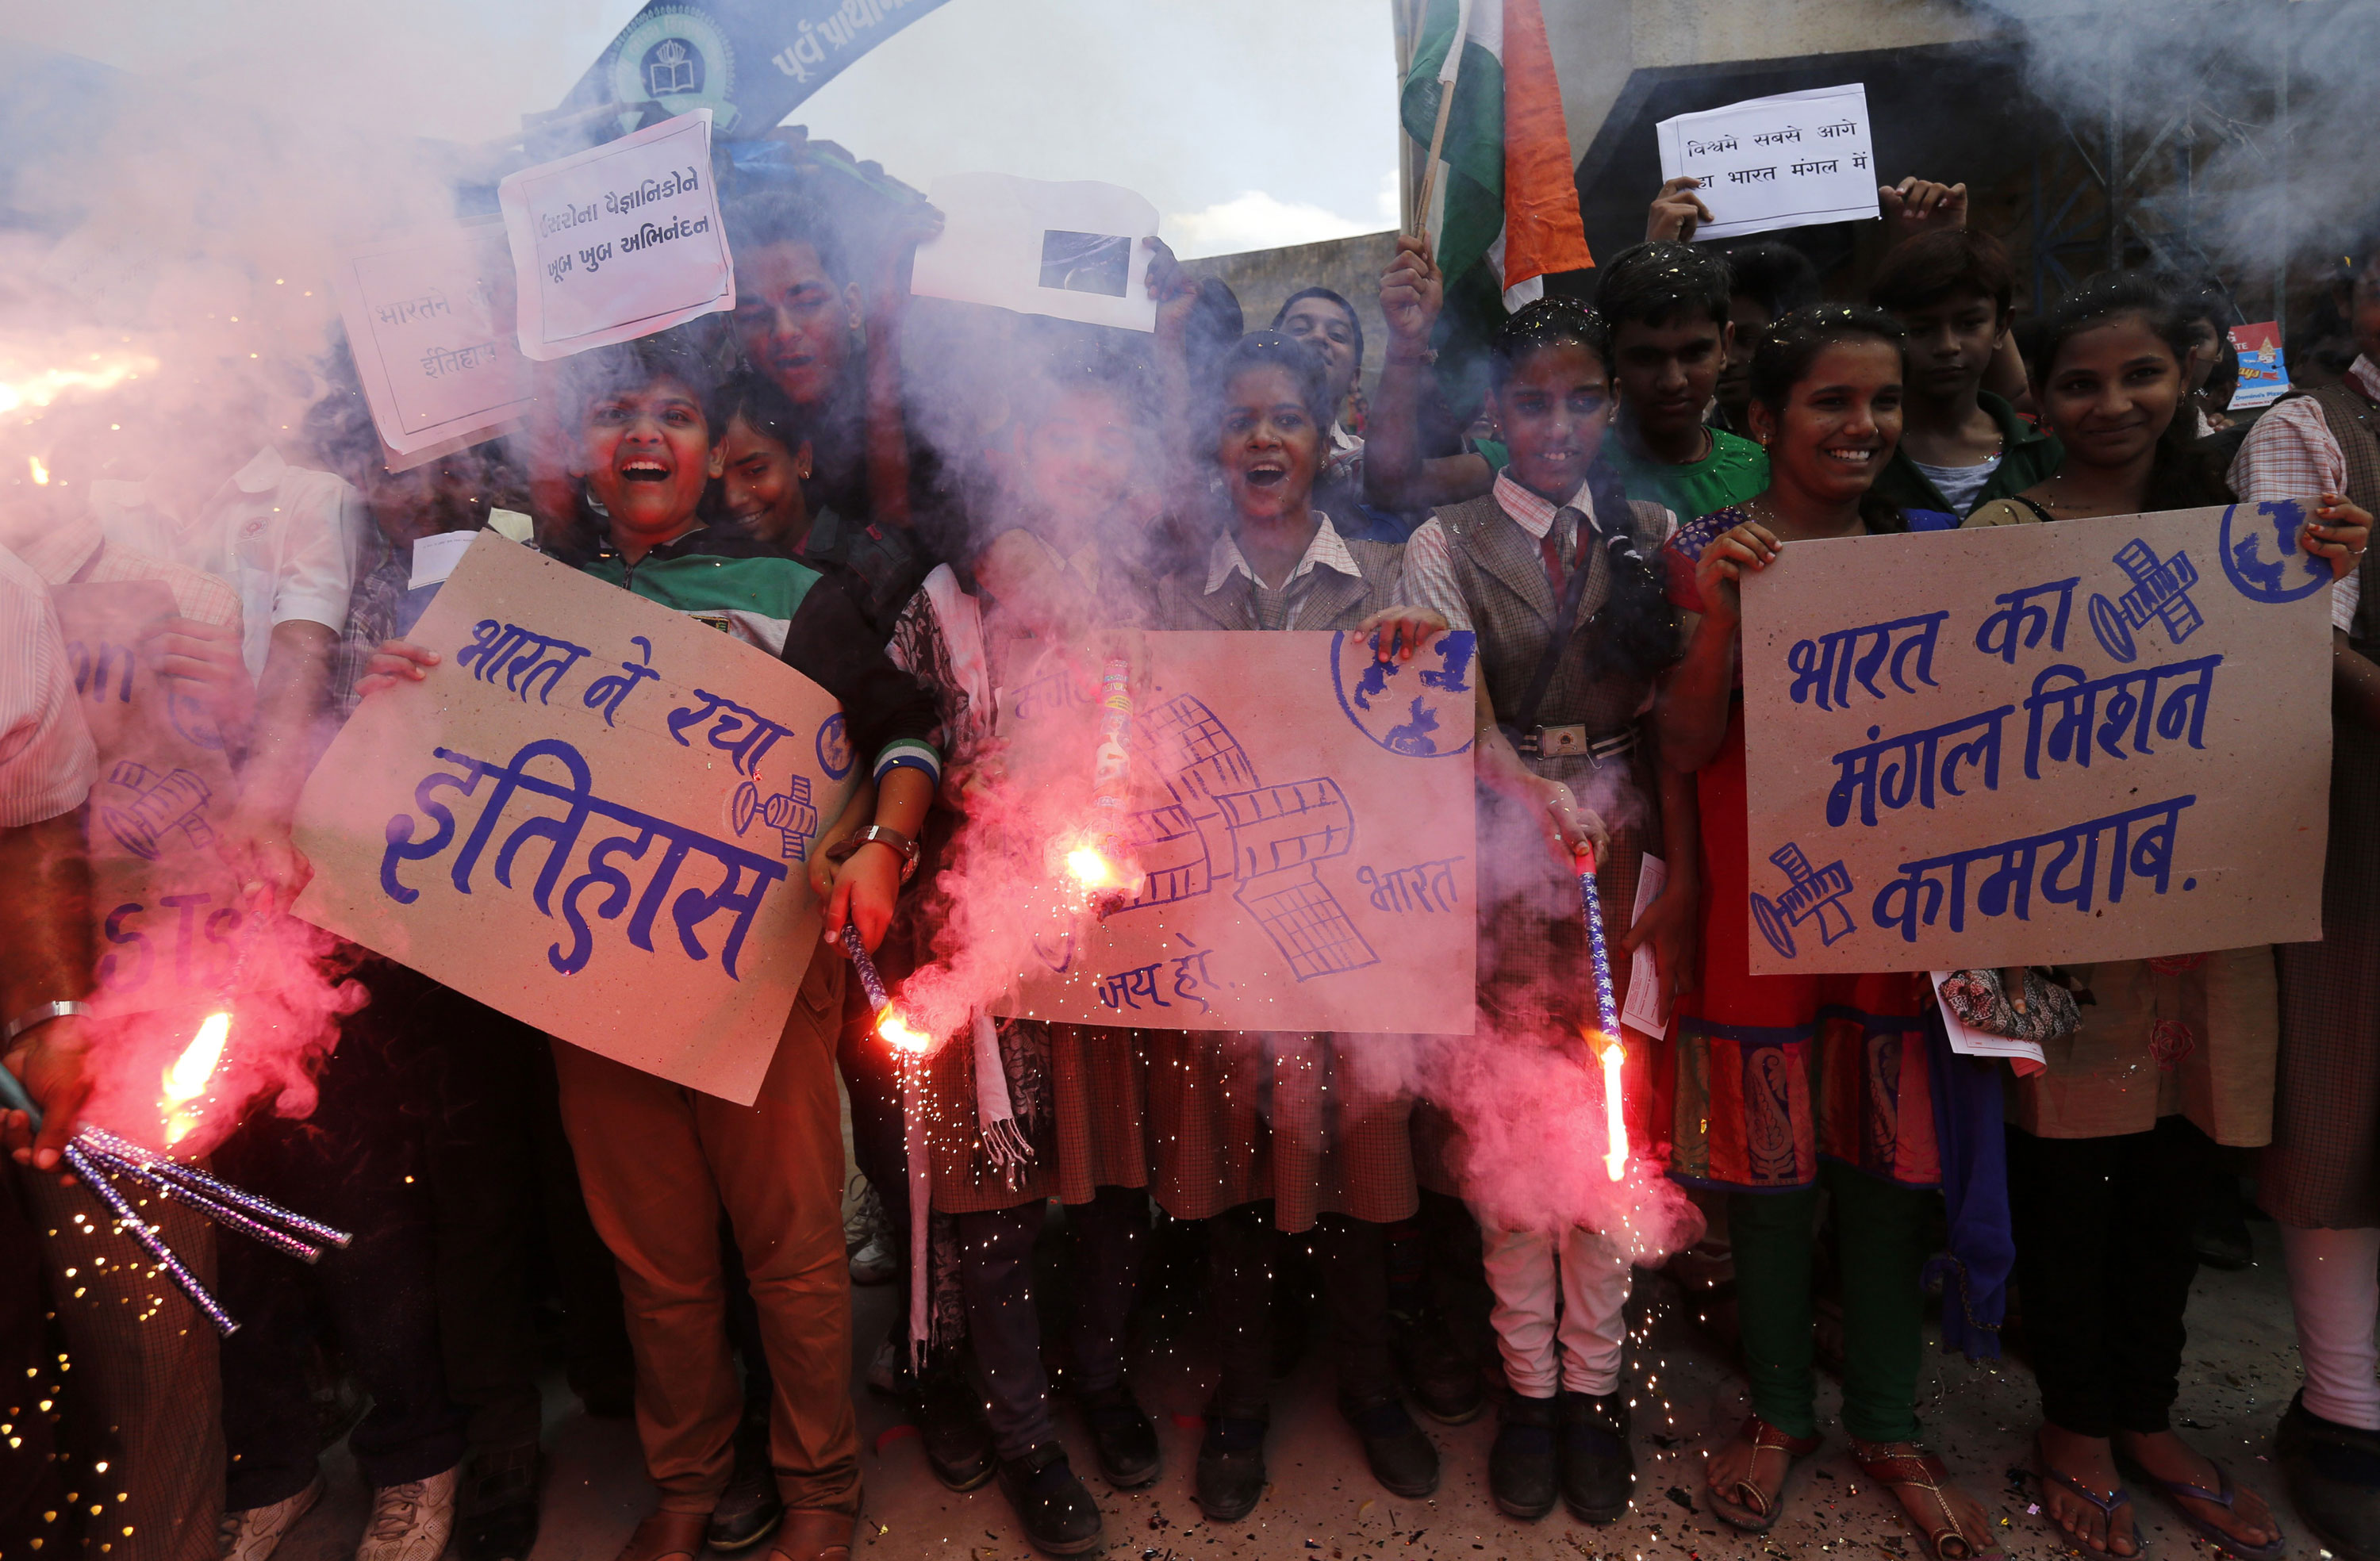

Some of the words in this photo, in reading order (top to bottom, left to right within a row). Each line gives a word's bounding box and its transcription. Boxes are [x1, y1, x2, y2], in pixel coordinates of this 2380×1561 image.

[1753, 125, 1802, 147] सबसे
[1818, 119, 1858, 138] आगे
[604, 166, 699, 215] વૈજ્ઞાનિકોને
[1728, 166, 1778, 185] भारत
[1791, 159, 1840, 176] मंगल
[1852, 151, 1868, 170] में
[547, 253, 573, 284] ખૂબ
[578, 241, 613, 273] ખુબ
[620, 215, 710, 253] અભિનંદન
[1787, 610, 1950, 712] भारत
[1975, 576, 2082, 665] का
[456, 619, 592, 705] भारत
[583, 635, 661, 729] ने
[667, 688, 795, 776] रचा
[1825, 704, 2015, 827] मंगल
[2023, 654, 2225, 780] मिशन
[379, 738, 789, 983] इतिहास
[1355, 855, 1466, 914] भारत
[1098, 962, 1171, 1011] जय
